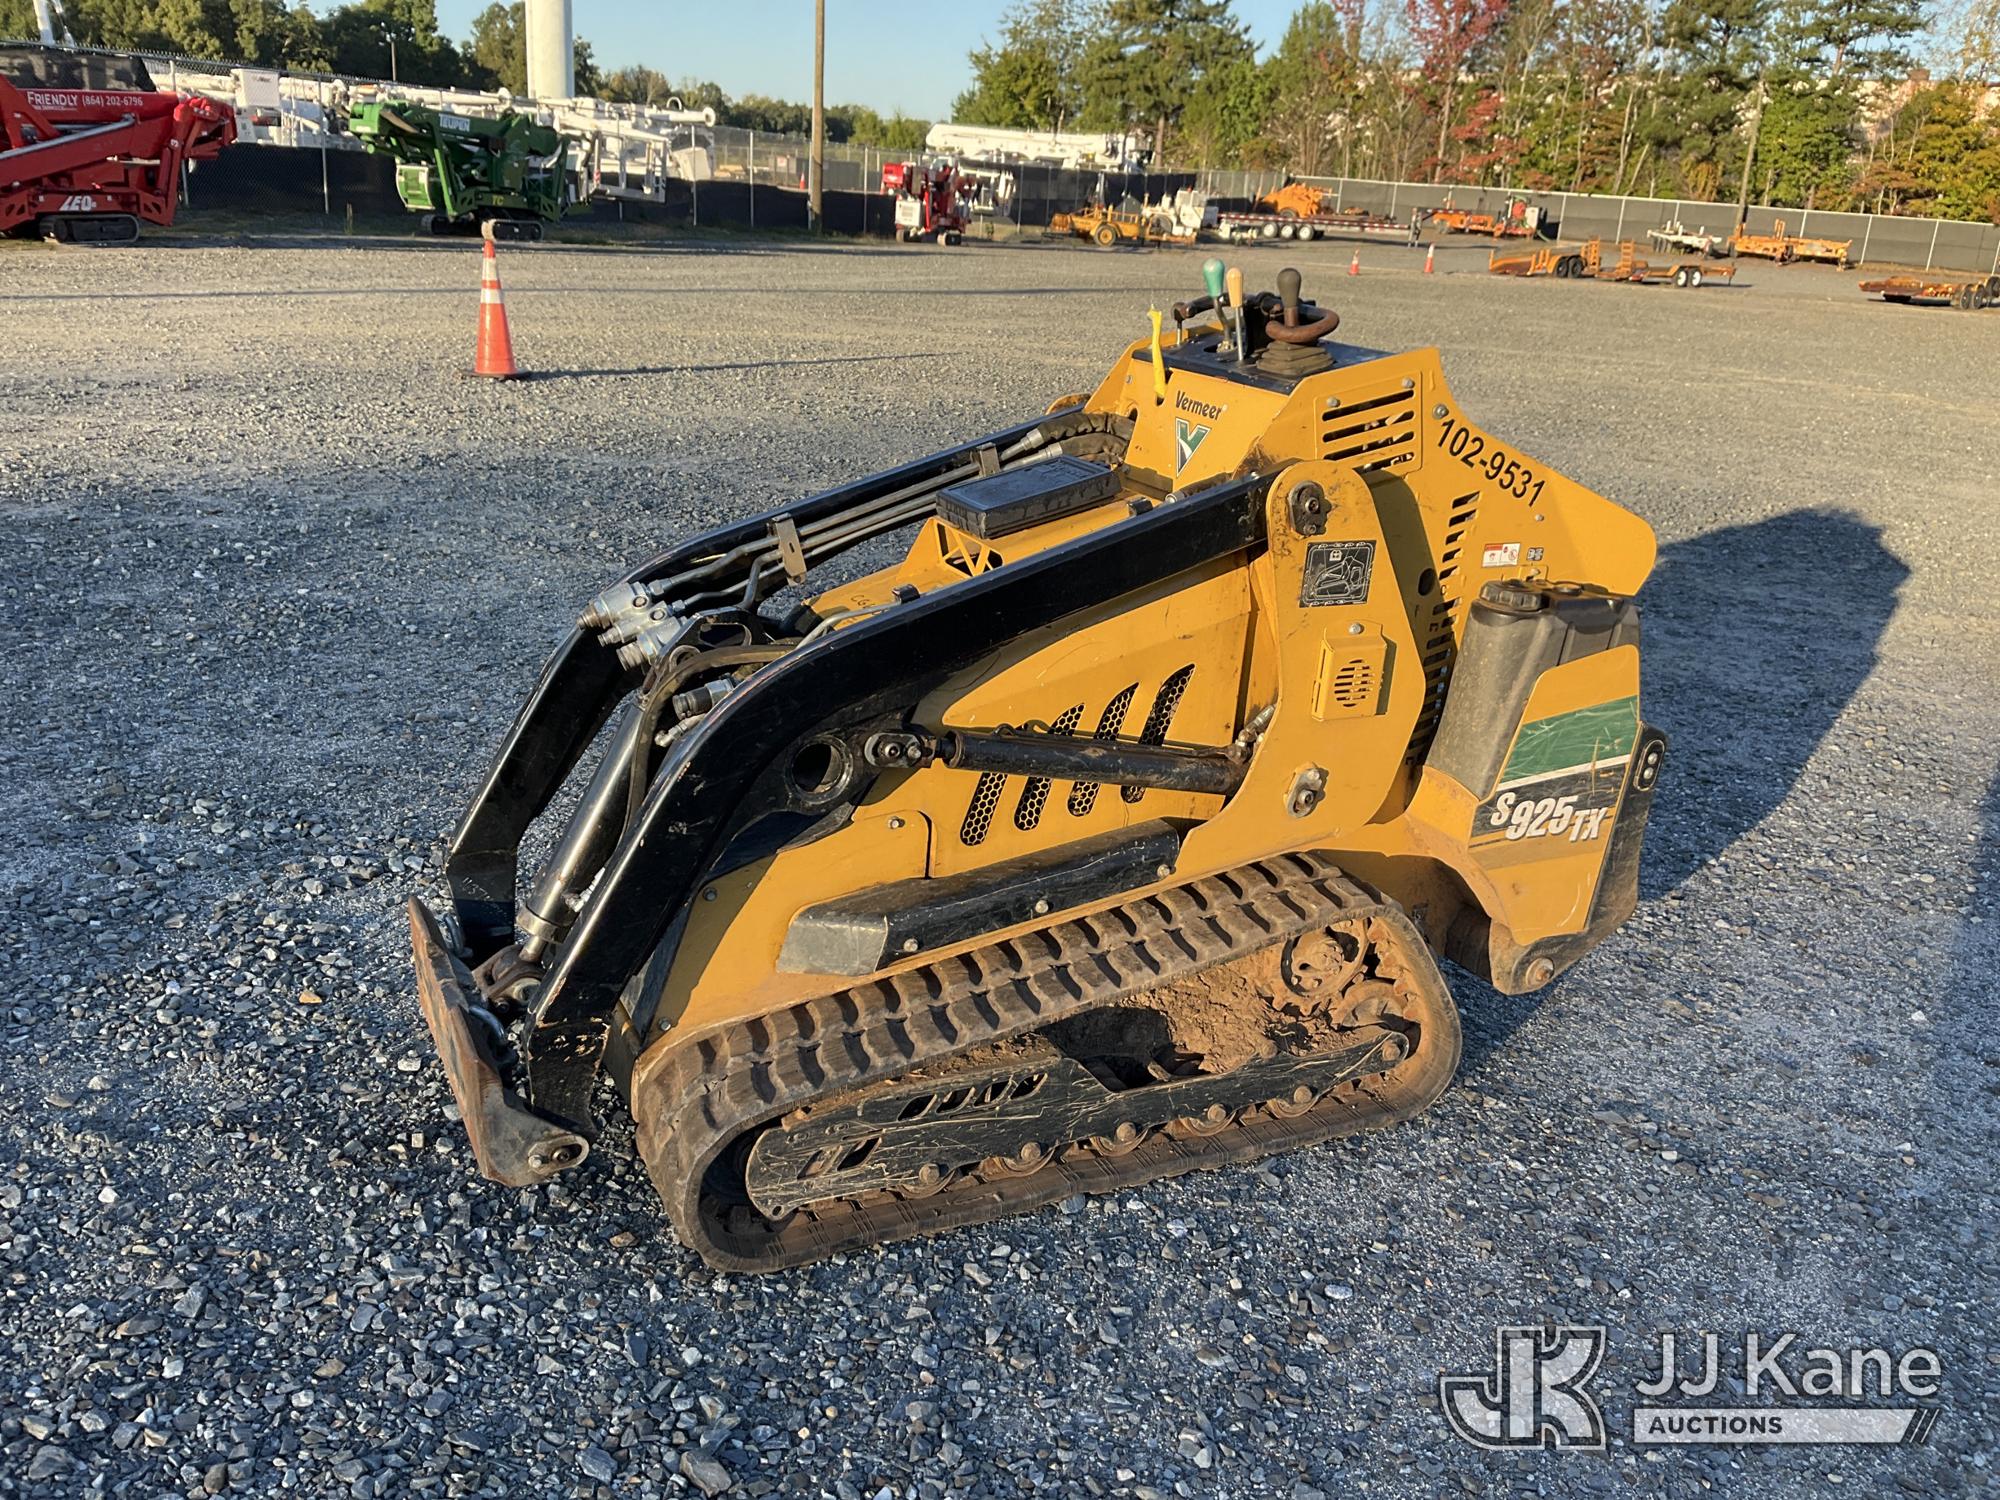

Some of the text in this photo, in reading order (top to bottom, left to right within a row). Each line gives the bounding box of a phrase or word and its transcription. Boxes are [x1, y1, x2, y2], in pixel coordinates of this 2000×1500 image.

[27, 91, 144, 107] FRIENDLY (864) 202-6796
[59, 195, 92, 211] LEO
[1176, 390, 1222, 420] Vermeer
[1438, 418, 1546, 508] 102-9531
